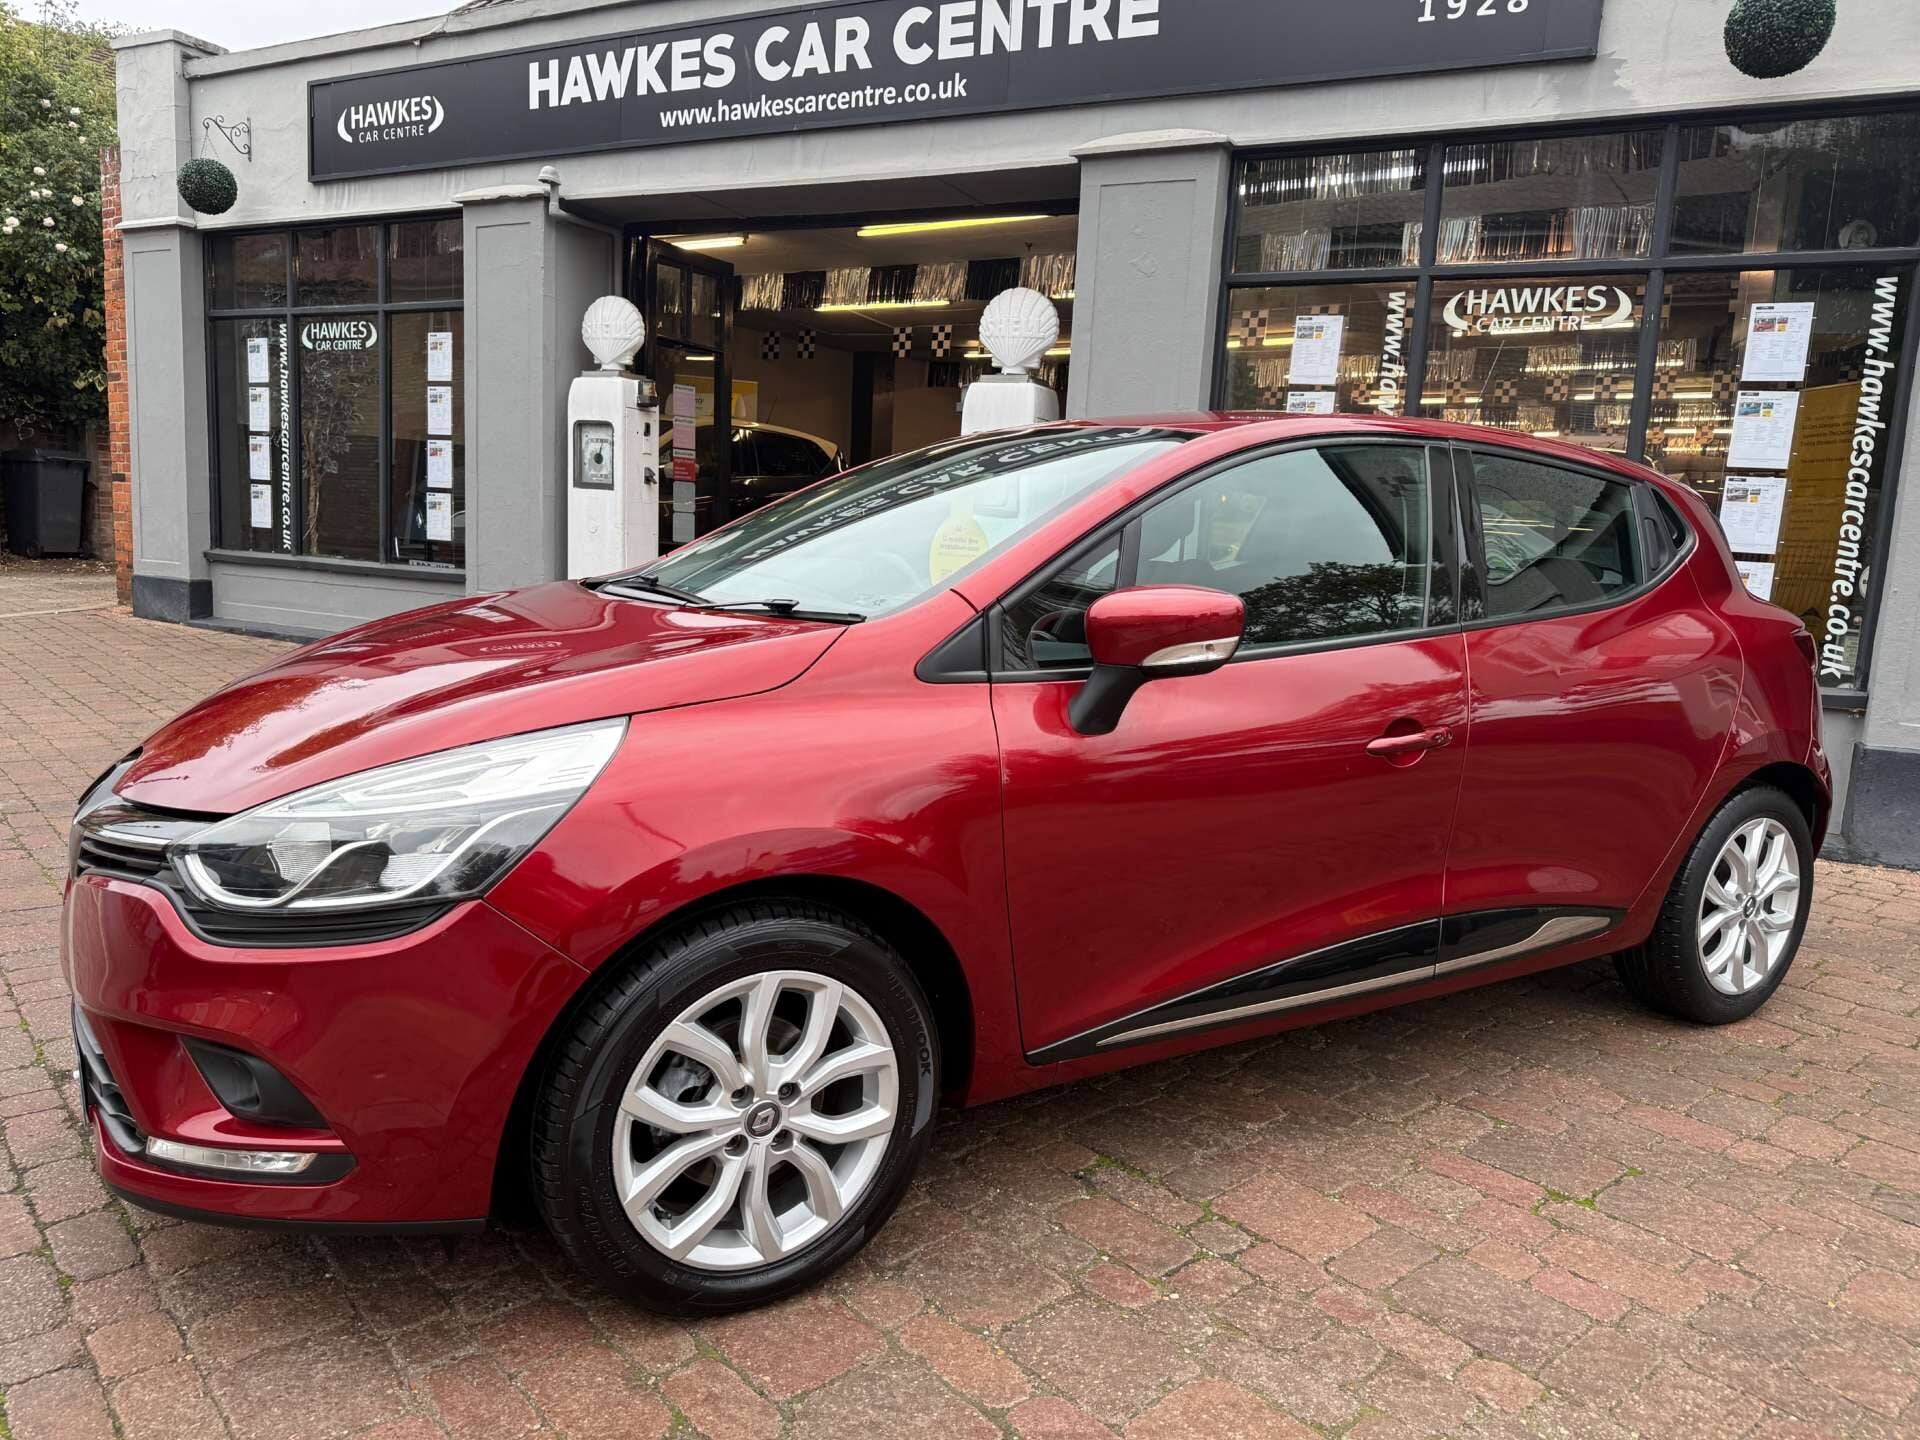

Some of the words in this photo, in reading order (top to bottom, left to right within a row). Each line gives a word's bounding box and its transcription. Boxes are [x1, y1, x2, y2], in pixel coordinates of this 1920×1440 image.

[528, 33, 736, 110] HAWKES
[754, 16, 873, 82] CAR
[892, 0, 1160, 65] CENTRE
[350, 95, 433, 130] HAWKES
[659, 72, 968, 128] www.hawkescarcentre.co.uk
[358, 130, 379, 144] CAR
[383, 124, 425, 140] CENTRE
[1465, 285, 1608, 315] HAWKES
[310, 320, 368, 339] HAWKES
[985, 318, 1043, 336] SHELL
[1476, 316, 1514, 333] CAR
[1519, 315, 1591, 332] CENTRE
[315, 340, 332, 351] CAR
[333, 339, 363, 351] CENTRE
[278, 323, 291, 550] www.hawkescarcentre.co.uk
[1819, 276, 1899, 680] www.hawkescarcentre.co.uk
